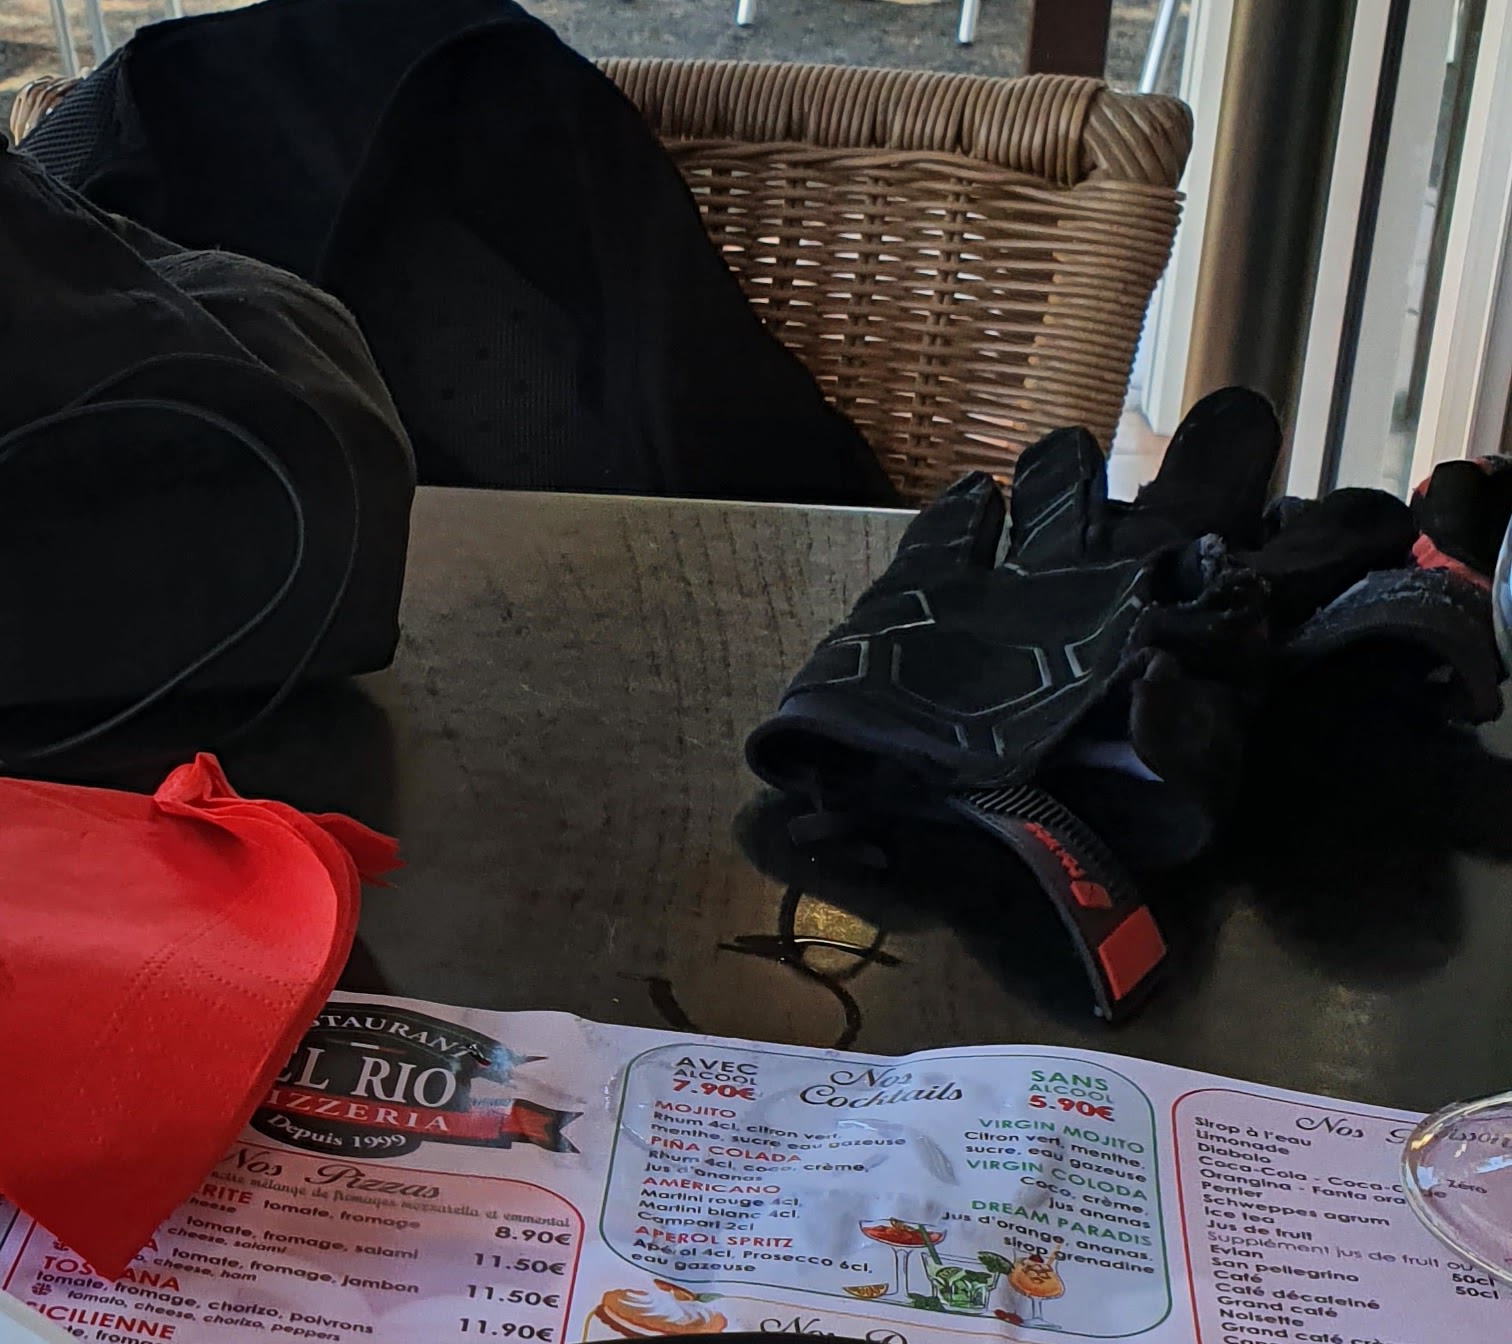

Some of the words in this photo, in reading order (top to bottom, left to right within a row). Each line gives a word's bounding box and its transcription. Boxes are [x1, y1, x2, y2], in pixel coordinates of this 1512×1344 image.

[674, 1068, 757, 1085] ALCOOL
[675, 1057, 759, 1075] AVEC
[351, 1056, 456, 1107] RIO
[672, 1079, 756, 1100] 7.90€
[1032, 1070, 1108, 1091] SANS
[1028, 1084, 1114, 1104] ALCOOL
[266, 1086, 451, 1132] IZZERIA
[654, 1100, 736, 1118] MOJITO
[1029, 1095, 1115, 1122] 5.90€
[266, 1112, 343, 1148] Depuis
[352, 1131, 407, 1150] 1999
[978, 1118, 1055, 1131] VIRGIN
[1063, 1125, 1145, 1153] MOJITO
[709, 1146, 802, 1162] COLADA
[303, 1161, 441, 1200] Pizzas
[642, 1177, 780, 1194] AMERICANO
[966, 1159, 1043, 1173] VIRGIN
[1051, 1169, 1148, 1200] COLODA
[1201, 1181, 1263, 1200] Perrier
[971, 1200, 1050, 1225] DREAM
[1058, 1218, 1152, 1246] PARADIS
[494, 1225, 572, 1247] 8.90€
[635, 1225, 719, 1245] APEROL
[727, 1236, 793, 1247] SPRITZ
[473, 1251, 567, 1276] 11.50€
[465, 1283, 560, 1309] 11.50€
[1220, 1308, 1304, 1328] Noisette
[459, 1318, 554, 1343] 11.90€
